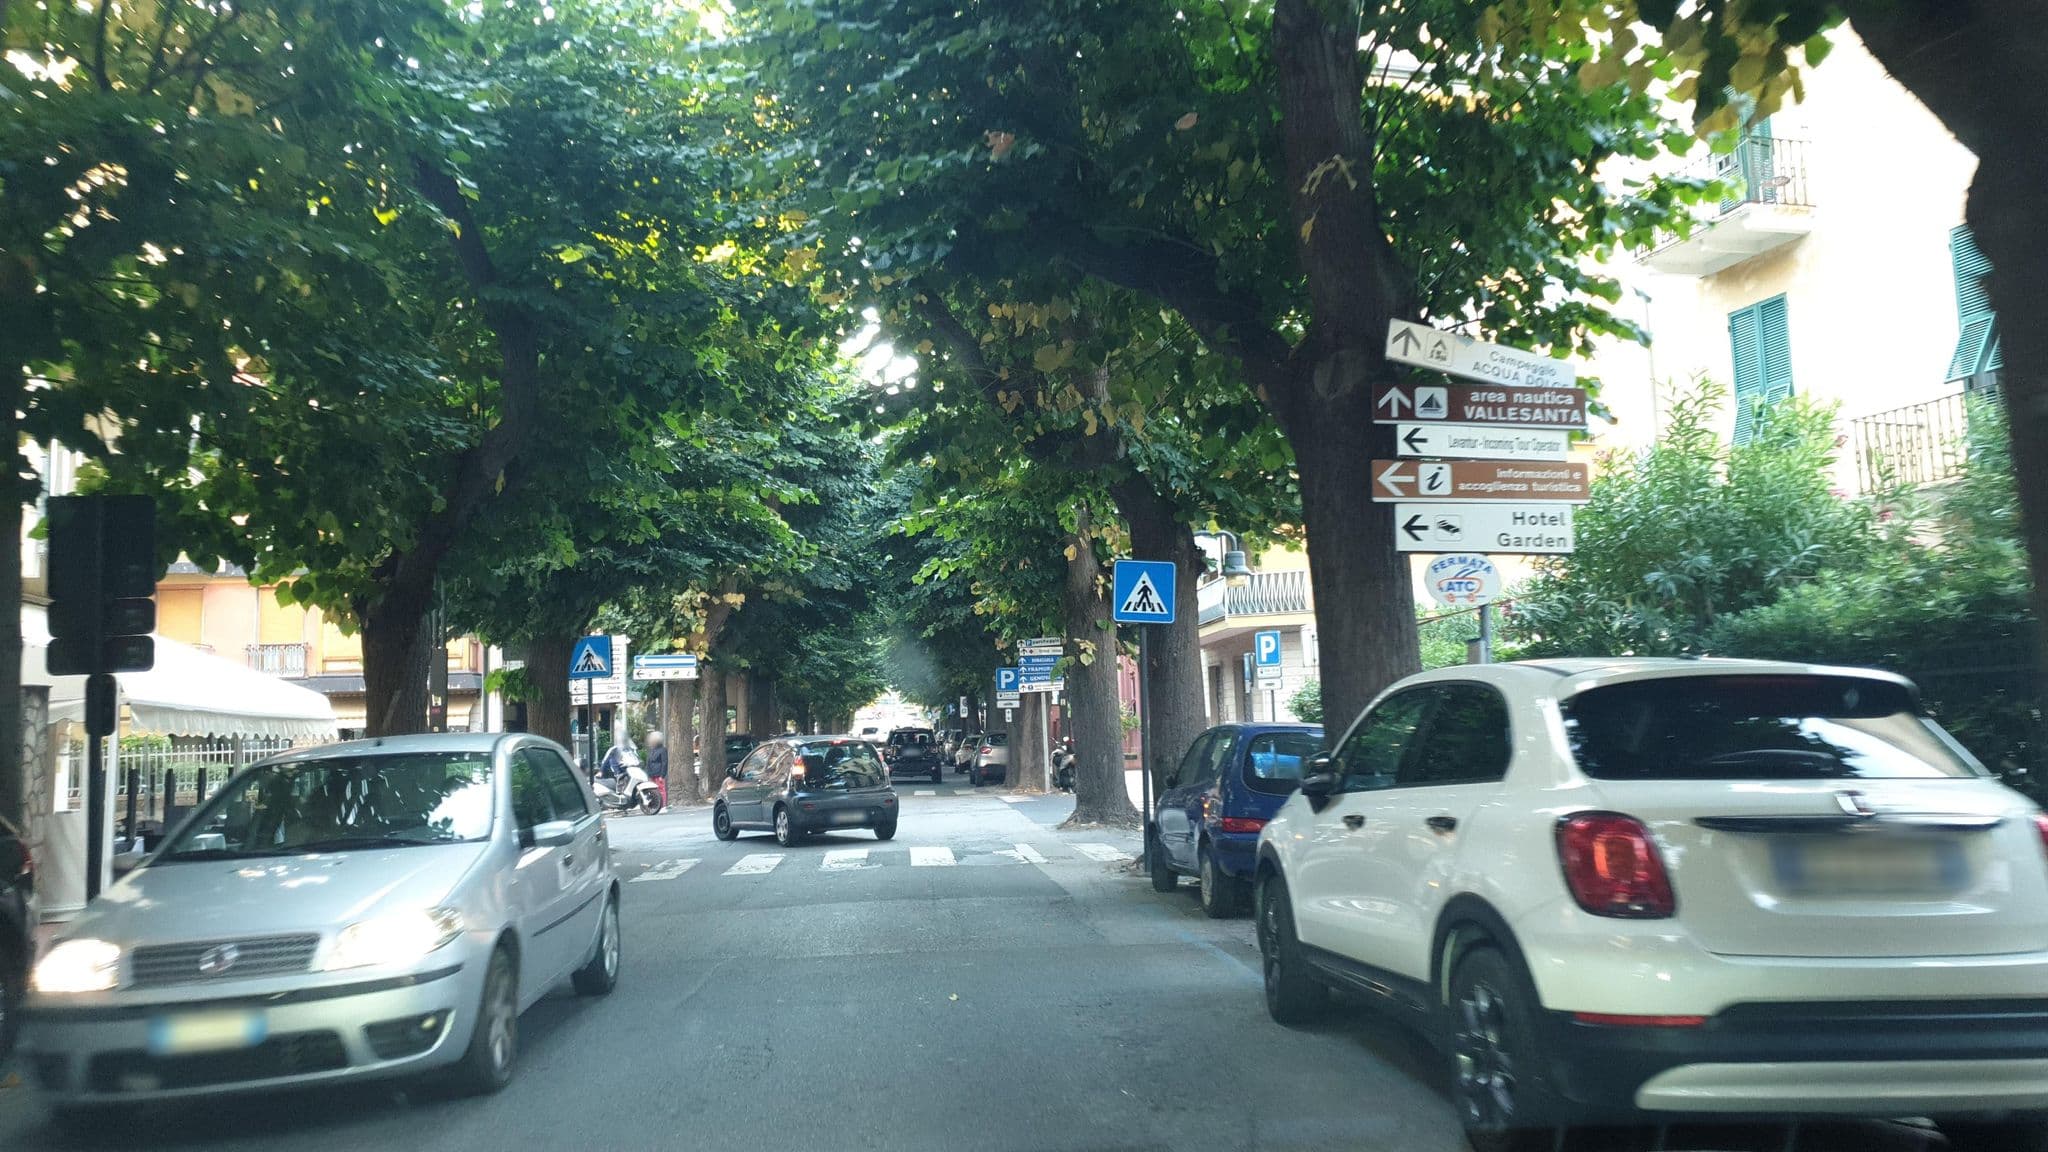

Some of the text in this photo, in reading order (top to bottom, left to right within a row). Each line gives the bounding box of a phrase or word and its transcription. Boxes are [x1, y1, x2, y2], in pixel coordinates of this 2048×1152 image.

[1472, 361, 1520, 383] ACQUA
[1489, 351, 1557, 377] Campeggio
[1470, 391, 1575, 406] area nautica
[1464, 406, 1583, 424] VALLESANTA
[1514, 436, 1531, 451] Tour
[1496, 468, 1582, 480] informazioni e
[1458, 481, 1582, 494] accoglienza turistica
[1512, 511, 1566, 527] Hotel
[1497, 533, 1568, 548] Garden
[1431, 555, 1493, 575] FERMATA
[1445, 581, 1476, 592] ATC
[1260, 635, 1276, 662] P
[1000, 670, 1015, 689] P
